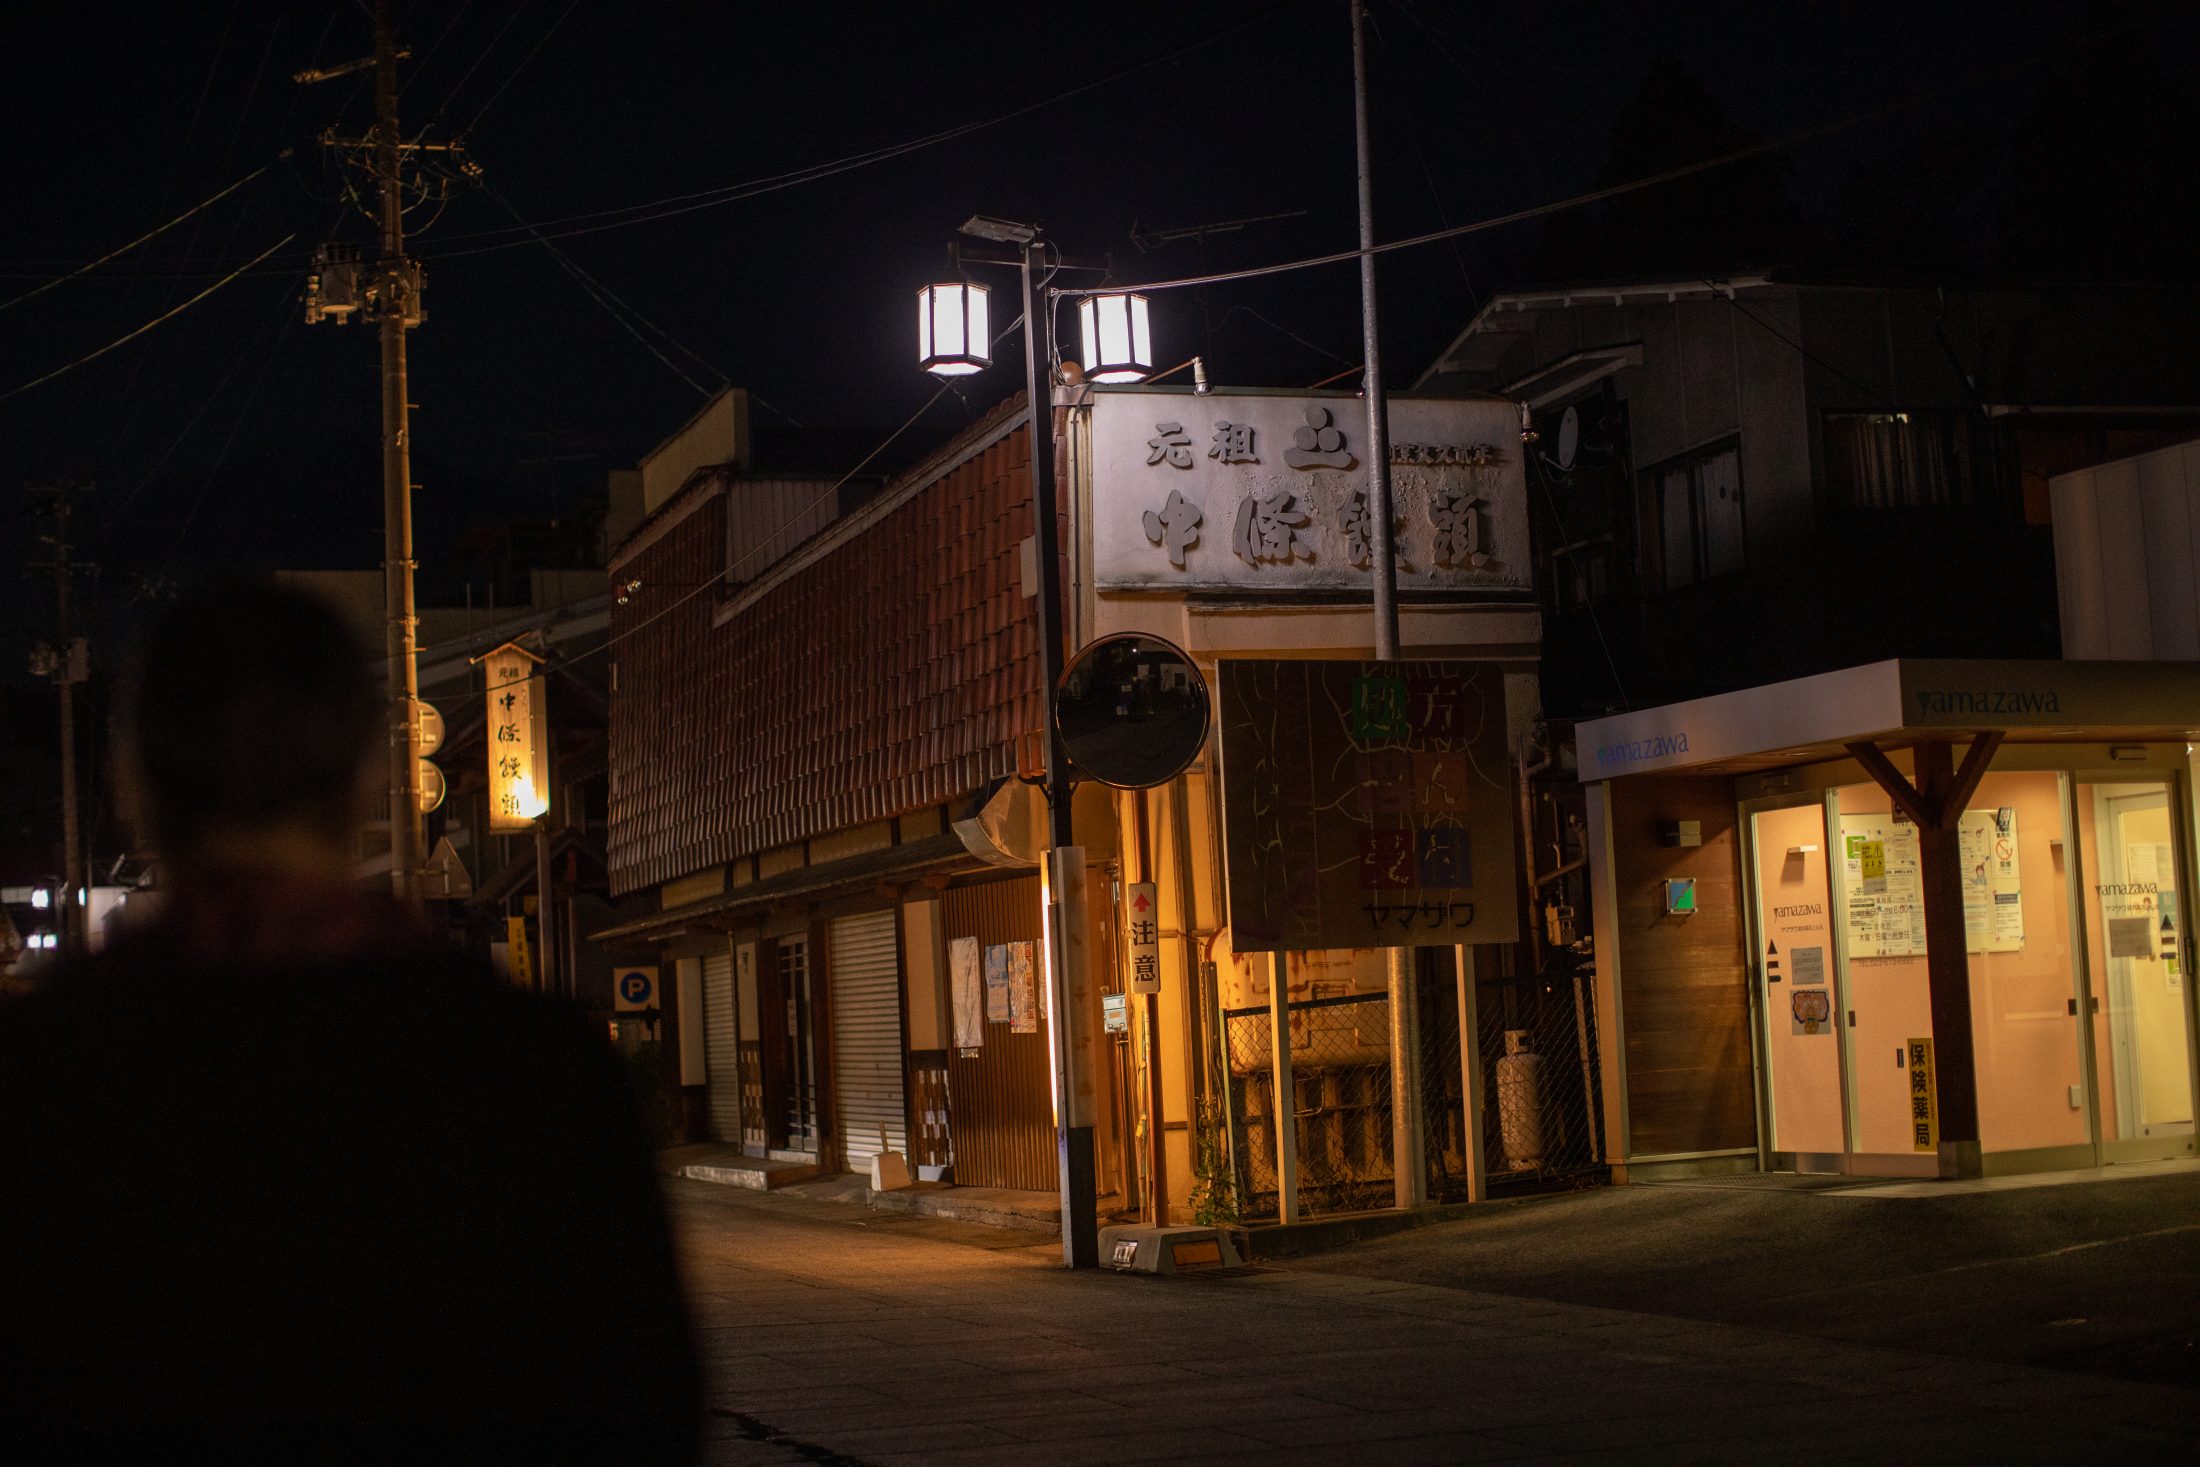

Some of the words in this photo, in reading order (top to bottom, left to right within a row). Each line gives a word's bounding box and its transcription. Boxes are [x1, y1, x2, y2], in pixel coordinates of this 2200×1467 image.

[1147, 420, 1258, 468] 元祖
[497, 667, 519, 679] 元祖
[1916, 691, 2061, 723] yamazawa
[1597, 732, 1690, 769] yamazawa
[2094, 882, 2159, 902] yamazawa
[1773, 903, 1823, 924] yamazawa
[1132, 920, 1156, 983] 注意
[628, 978, 645, 998] P
[1909, 1043, 1930, 1147] 保険薬局
